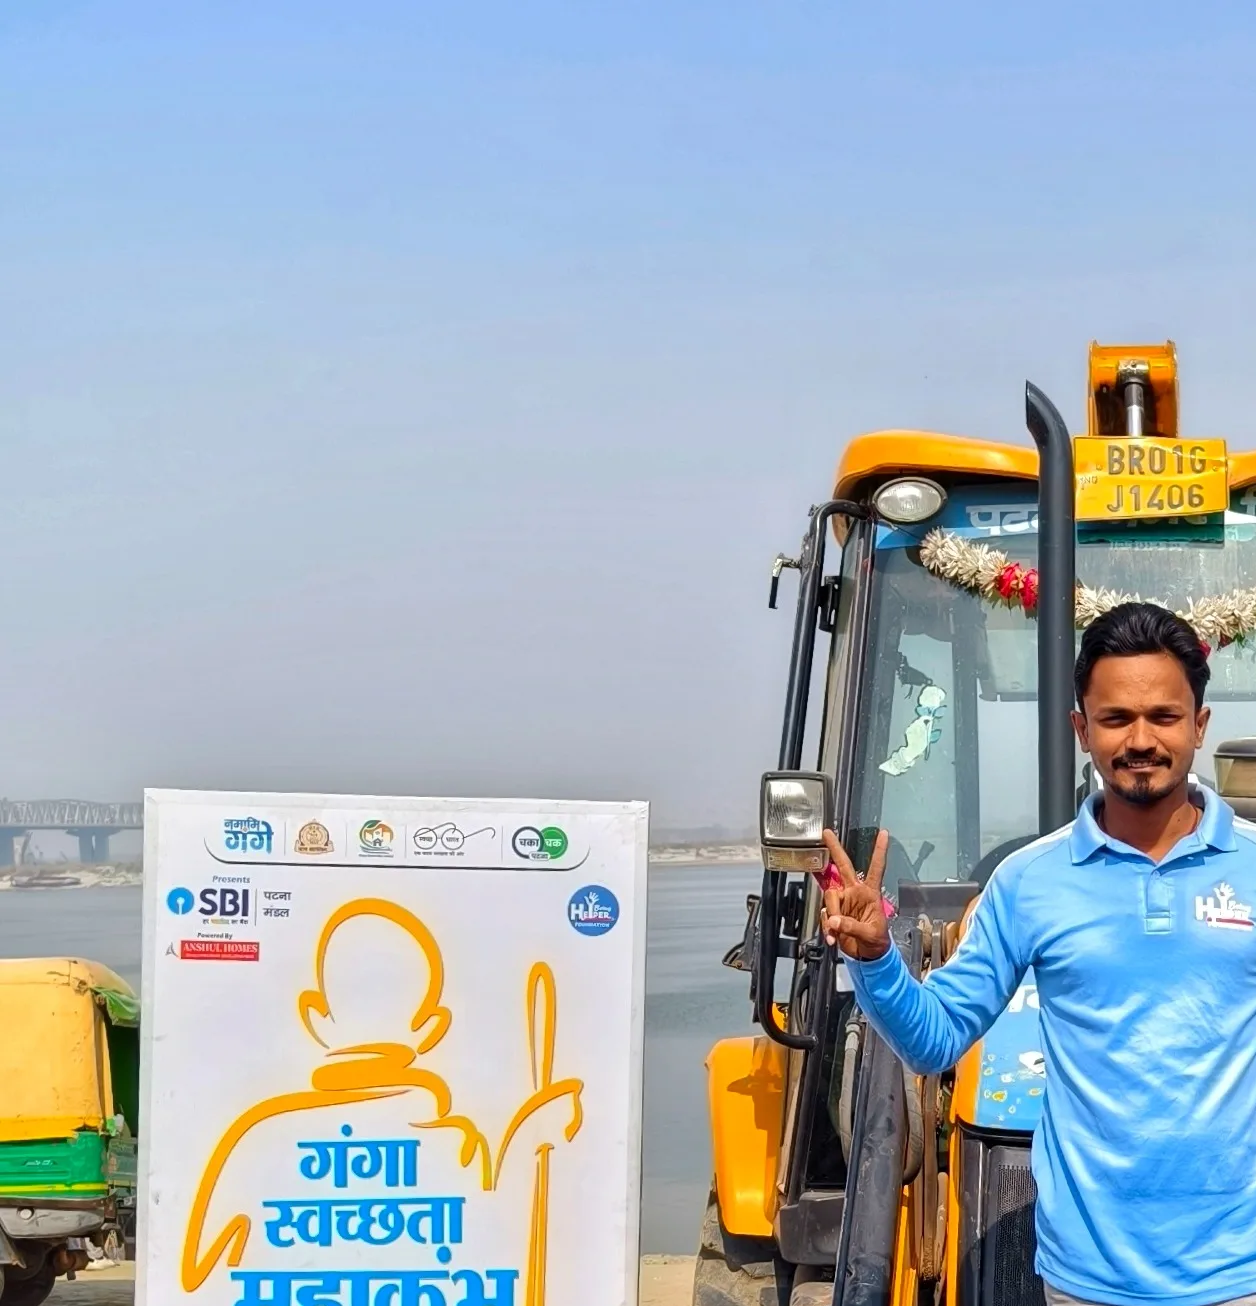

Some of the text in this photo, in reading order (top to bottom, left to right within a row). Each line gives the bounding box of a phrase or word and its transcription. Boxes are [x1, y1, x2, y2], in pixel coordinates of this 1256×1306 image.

[1108, 445, 1206, 475] BR01G
[1107, 484, 1204, 512] J1406
[212, 875, 250, 883] Presents
[198, 888, 249, 917] SBI
[264, 891, 292, 901] पटना
[223, 943, 258, 953] HOMES
[297, 1124, 420, 1188] गंगा
[262, 1197, 465, 1248] स्वच्छता
